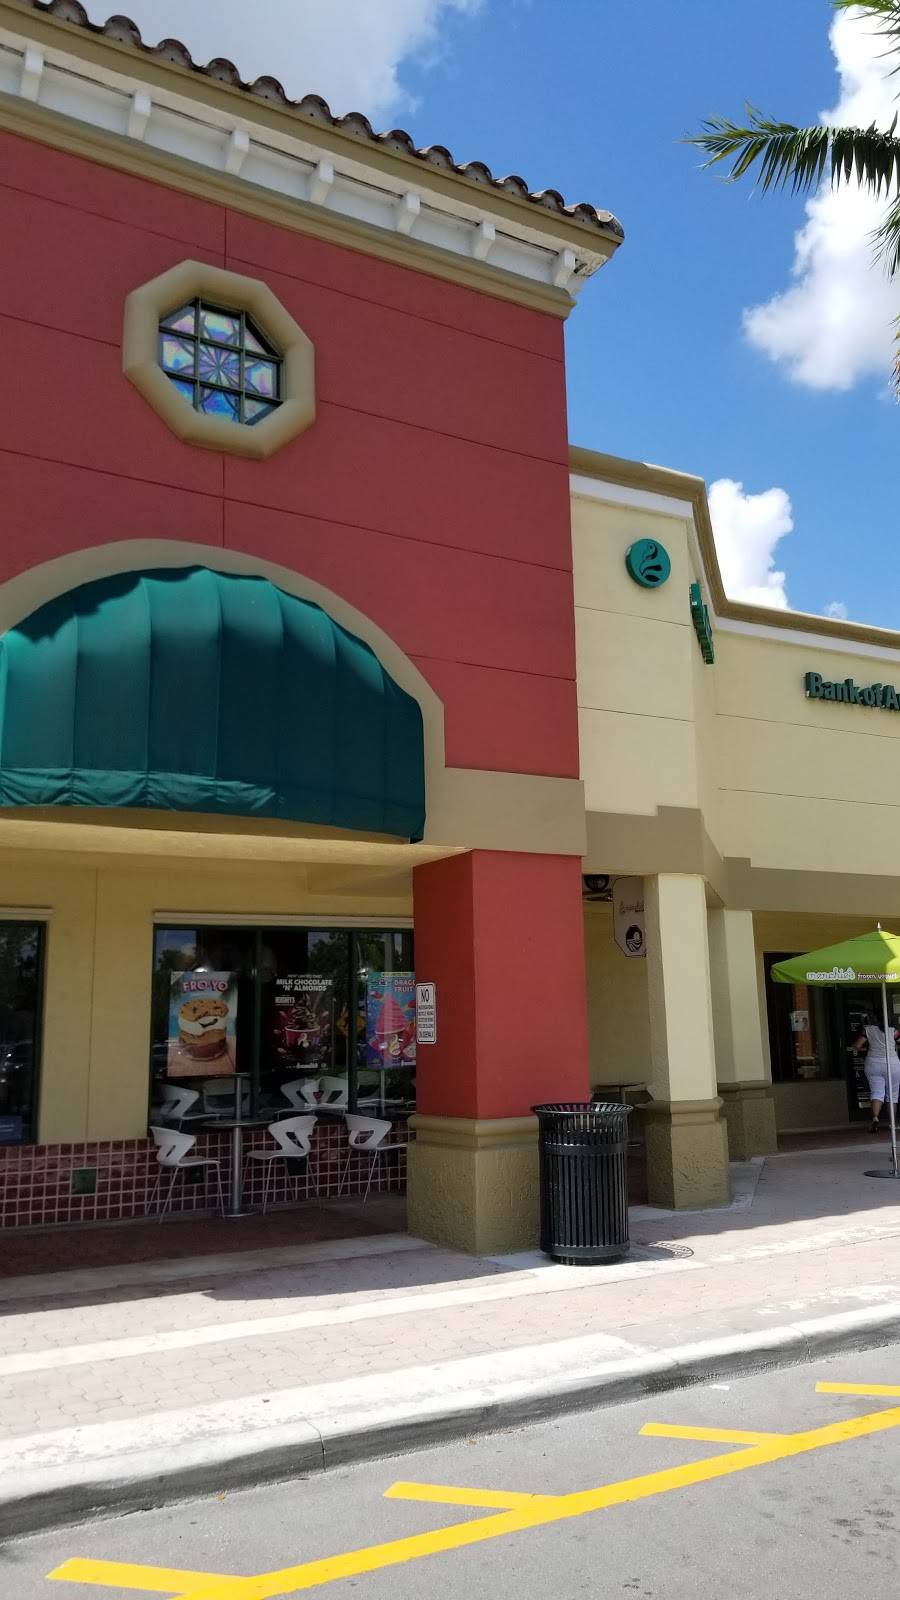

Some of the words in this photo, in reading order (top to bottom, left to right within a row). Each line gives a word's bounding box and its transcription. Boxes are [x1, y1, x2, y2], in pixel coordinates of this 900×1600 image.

[805, 672, 861, 703] Bank
[859, 683, 883, 707] of
[882, 685, 900, 711] A
[294, 978, 333, 986] CHOCOLATE
[420, 988, 430, 1002] NO
